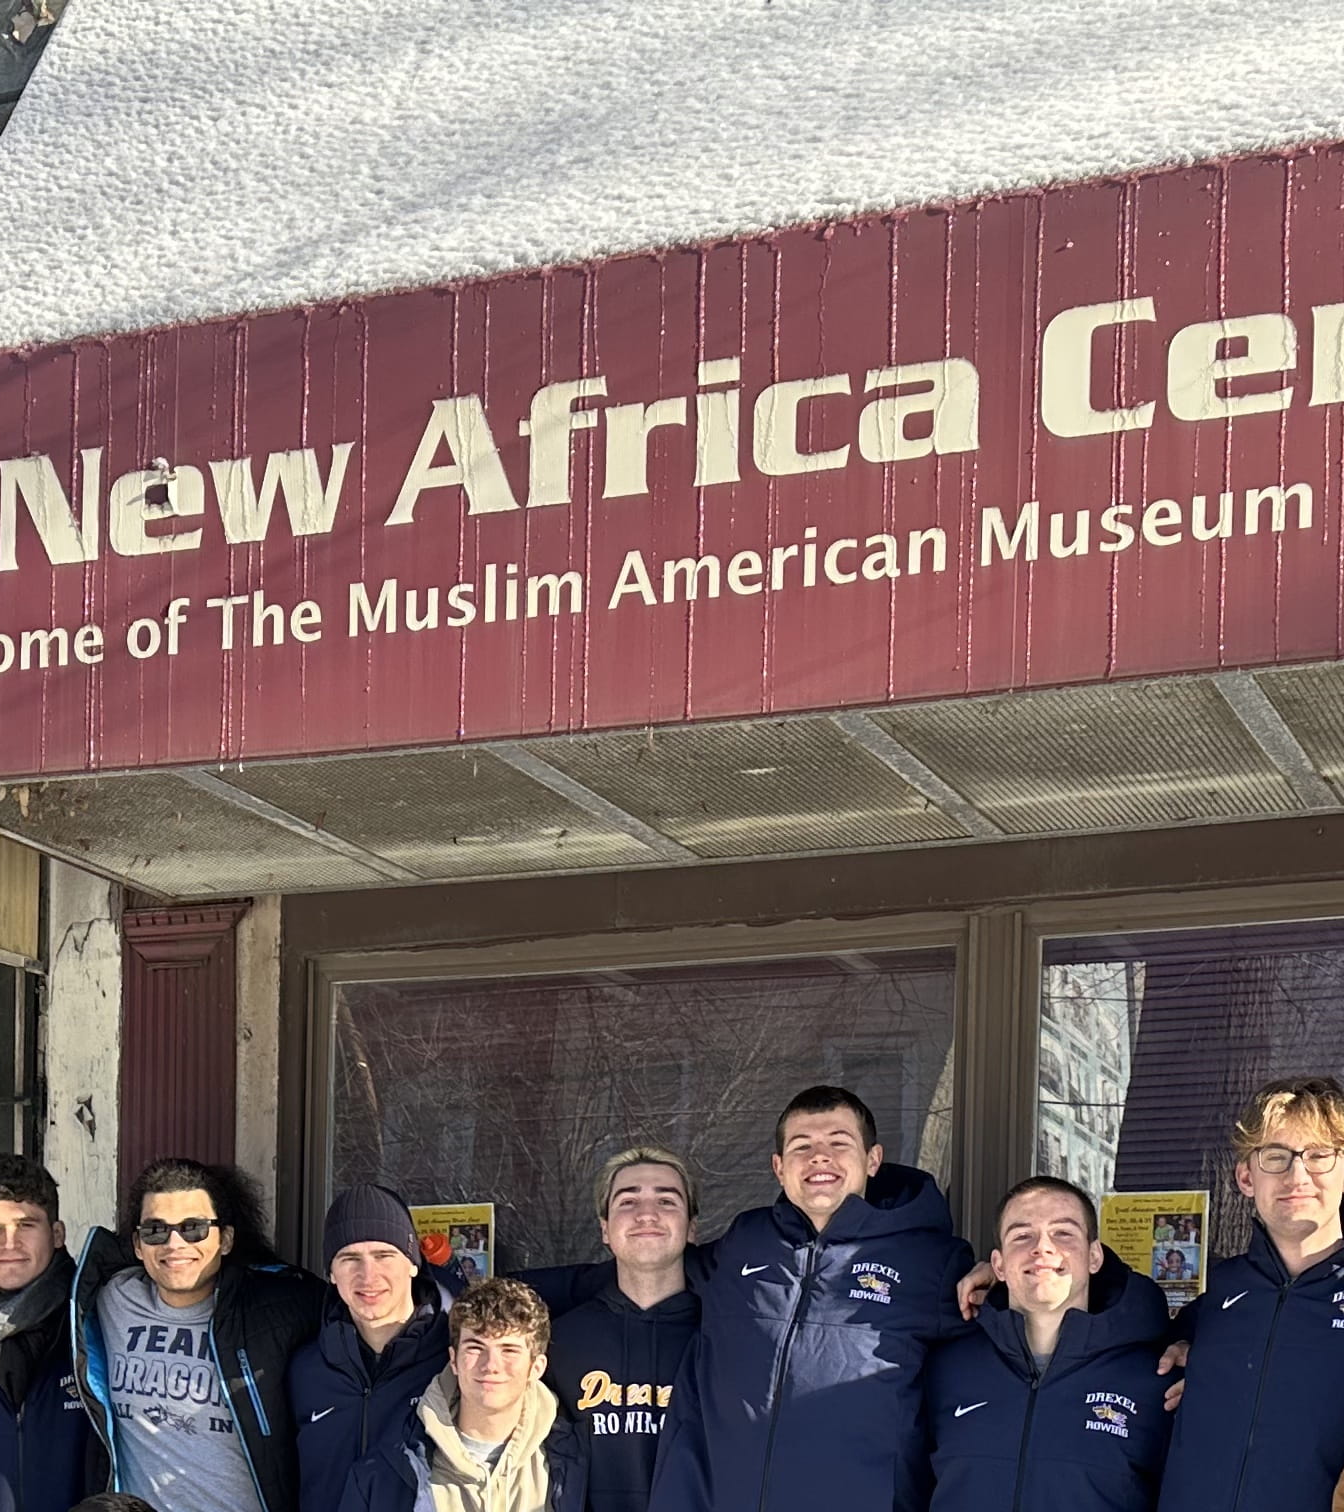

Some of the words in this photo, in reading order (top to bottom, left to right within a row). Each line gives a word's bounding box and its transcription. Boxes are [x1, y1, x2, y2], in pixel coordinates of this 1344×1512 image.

[384, 355, 979, 527] Africa
[126, 597, 190, 660] of
[207, 588, 322, 650] The
[348, 564, 584, 638] Muslim
[608, 527, 947, 610] American
[981, 484, 1314, 568] Museum
[851, 1262, 901, 1284] DREXEL
[1085, 1392, 1137, 1414] DREXEL
[1085, 1420, 1129, 1438] ROWING
